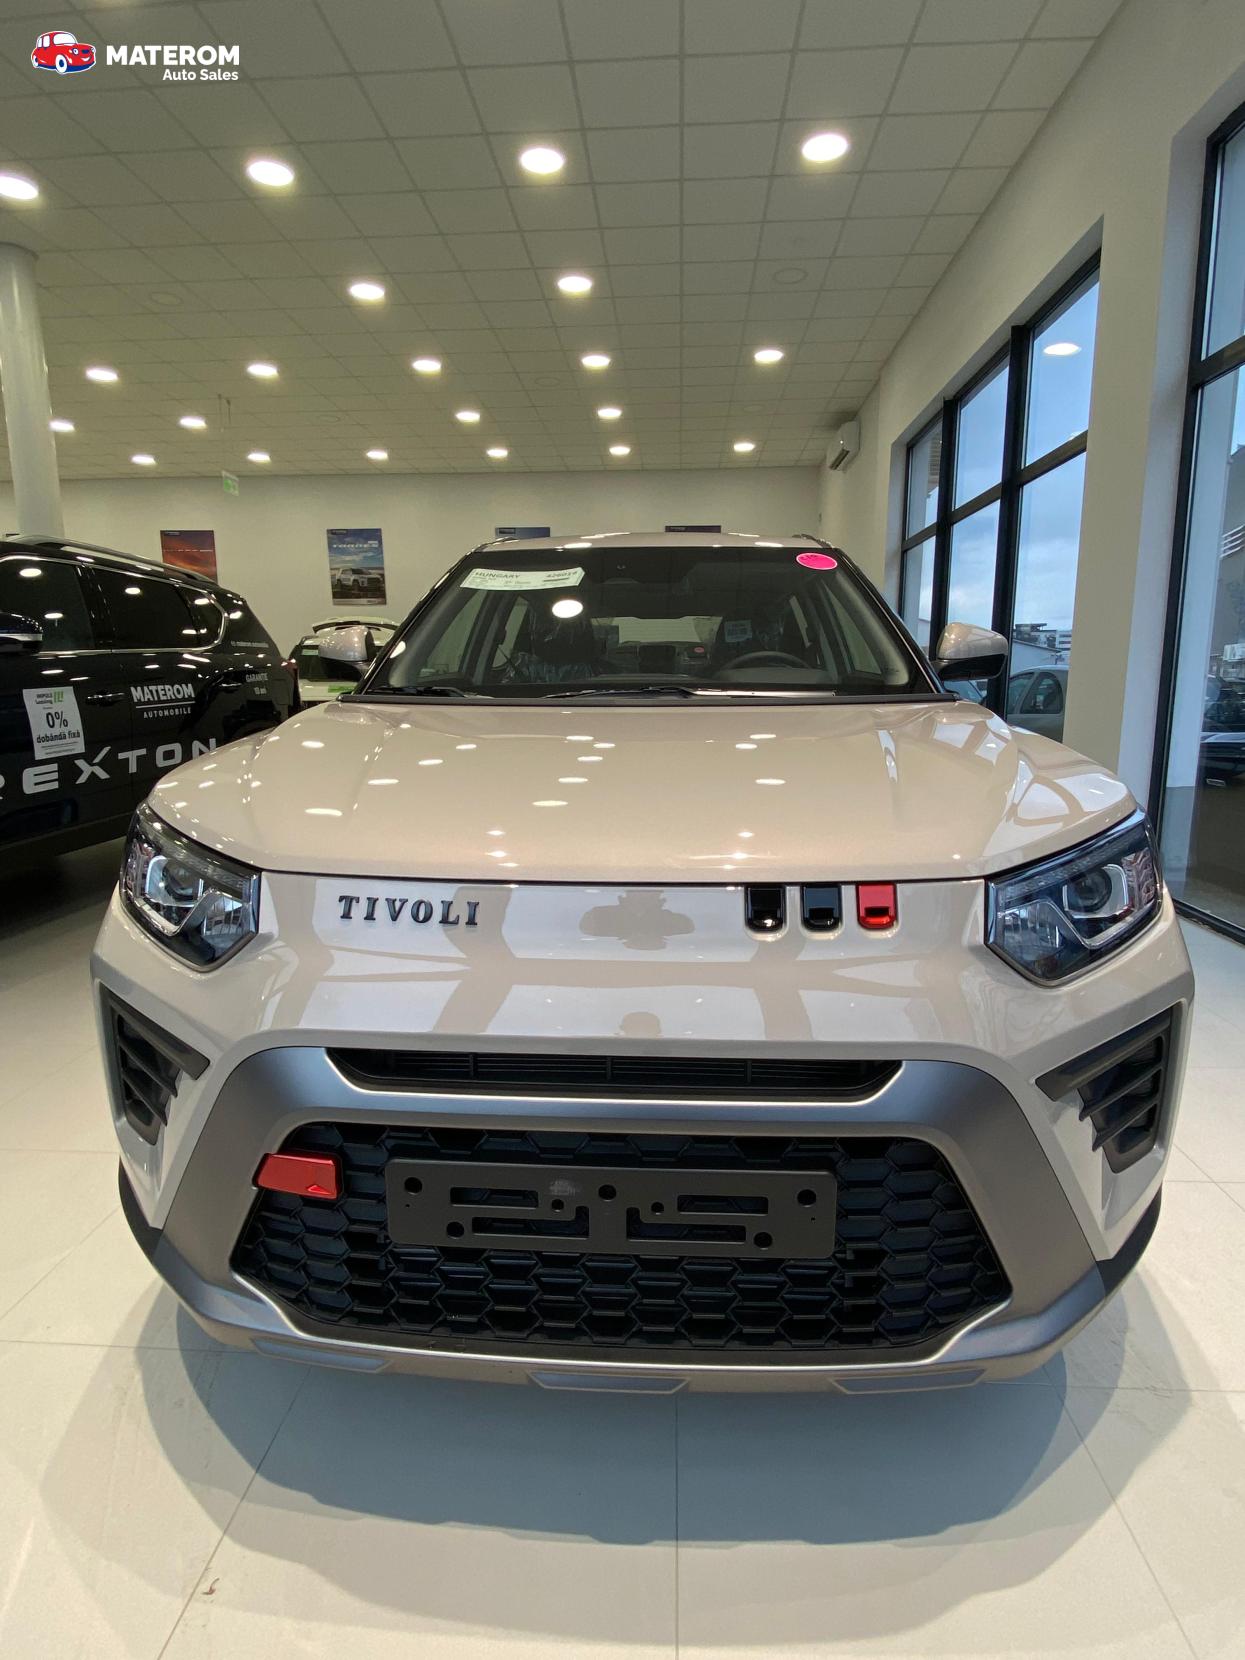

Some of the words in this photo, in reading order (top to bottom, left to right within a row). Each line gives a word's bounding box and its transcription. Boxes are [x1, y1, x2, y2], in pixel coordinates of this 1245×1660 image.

[475, 571, 520, 579] HUNGARY
[130, 683, 196, 703] MATEROM
[45, 710, 69, 729] 0%
[143, 706, 192, 719] AUTOMOBILE
[0, 738, 217, 800] EXTON
[338, 894, 480, 926] TIVOLI
